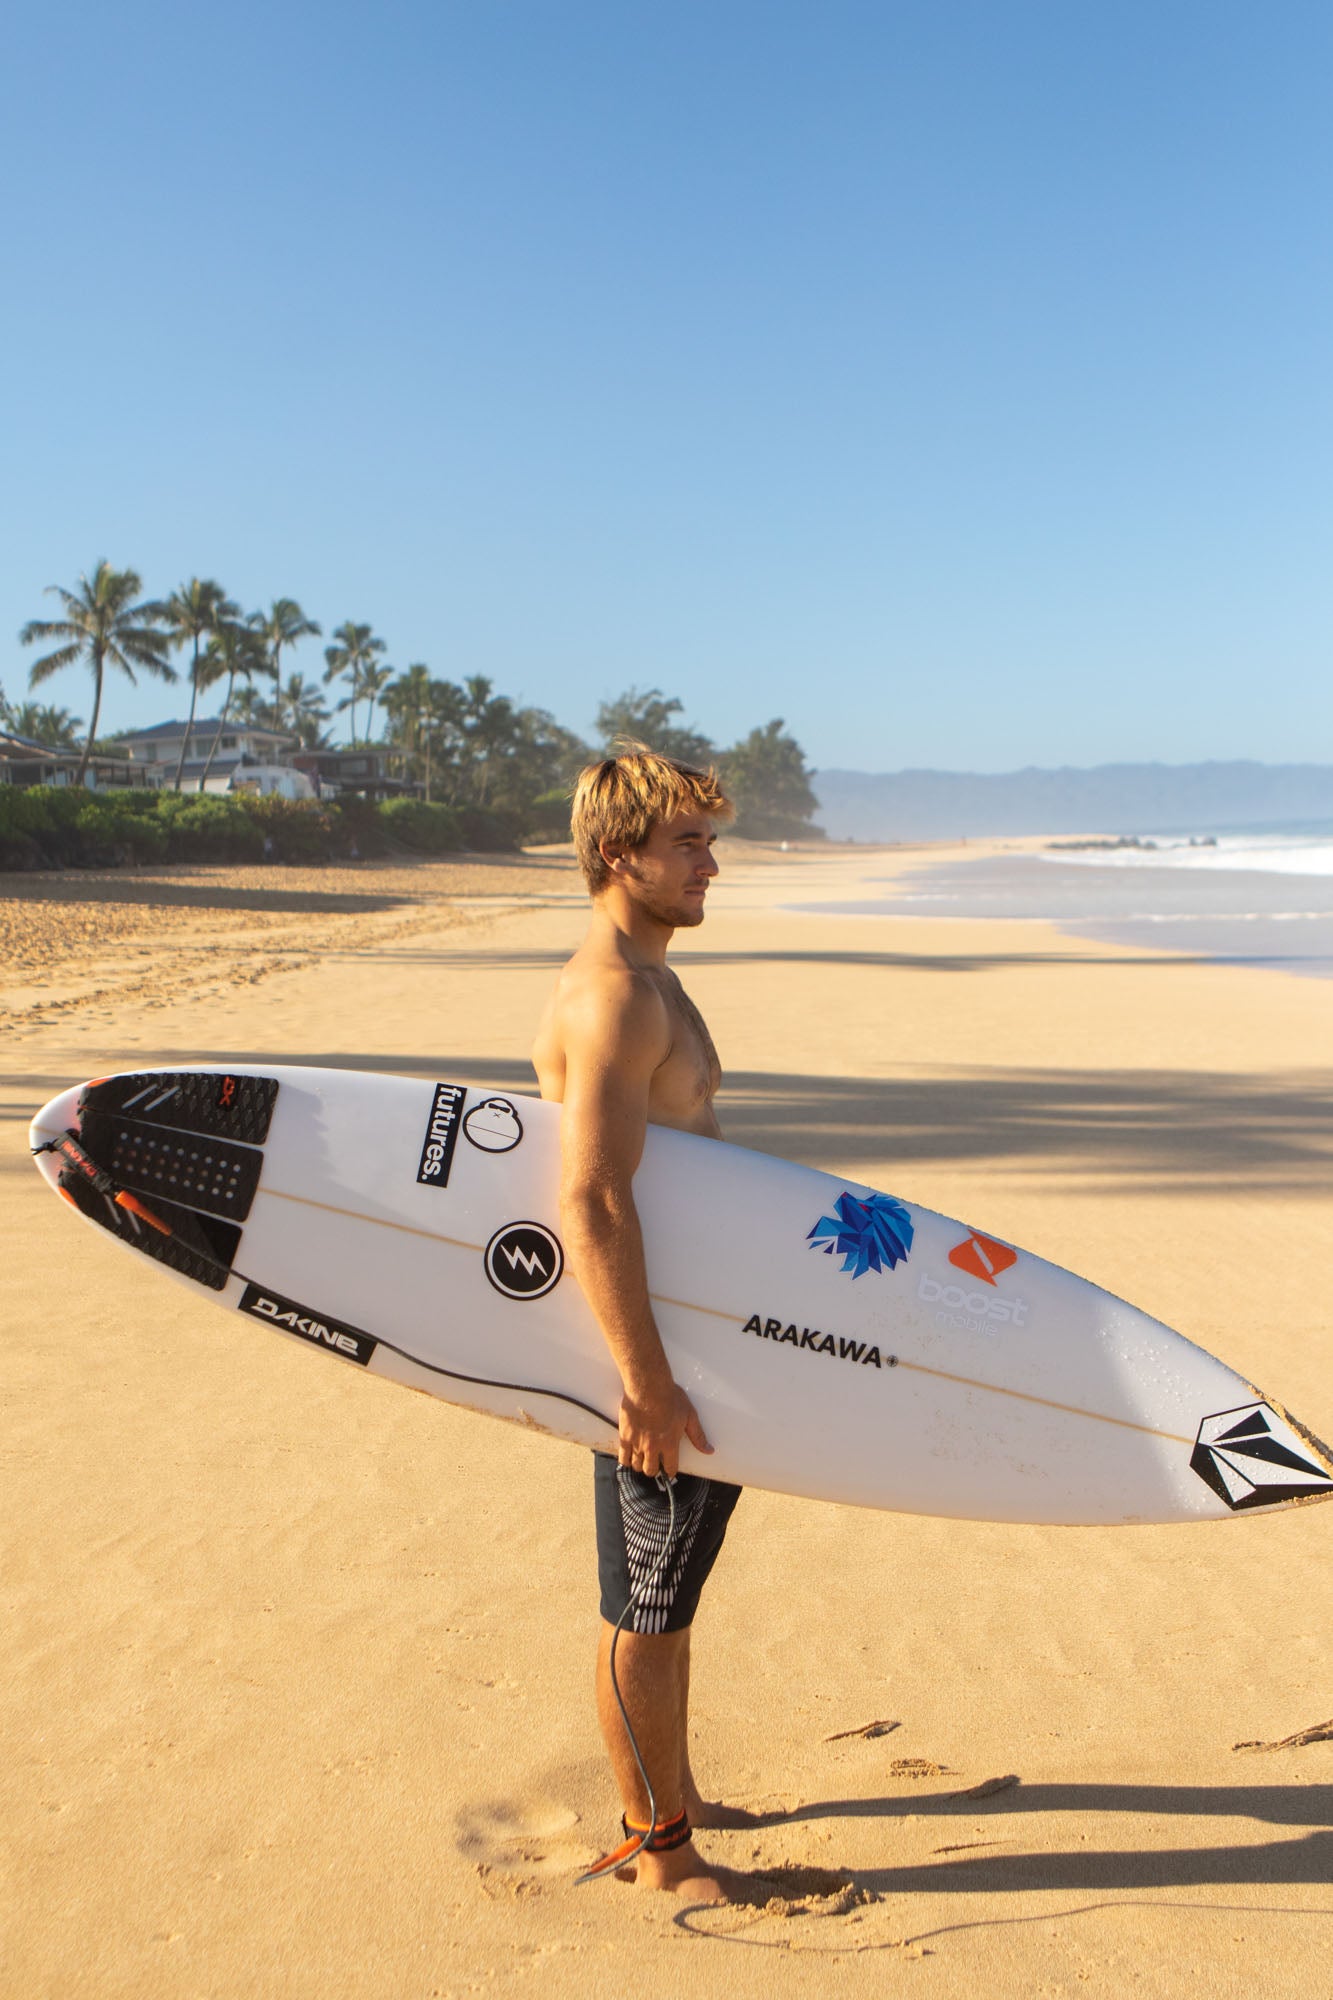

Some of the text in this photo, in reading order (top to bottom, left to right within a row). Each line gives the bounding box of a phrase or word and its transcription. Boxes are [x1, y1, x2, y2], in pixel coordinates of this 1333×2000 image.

[422, 1087, 462, 1180] futures.
[250, 1297, 359, 1356] DAKINE
[919, 1273, 1029, 1327] boost
[936, 1311, 998, 1336] mobile
[742, 1314, 882, 1368] ARAKAWA
